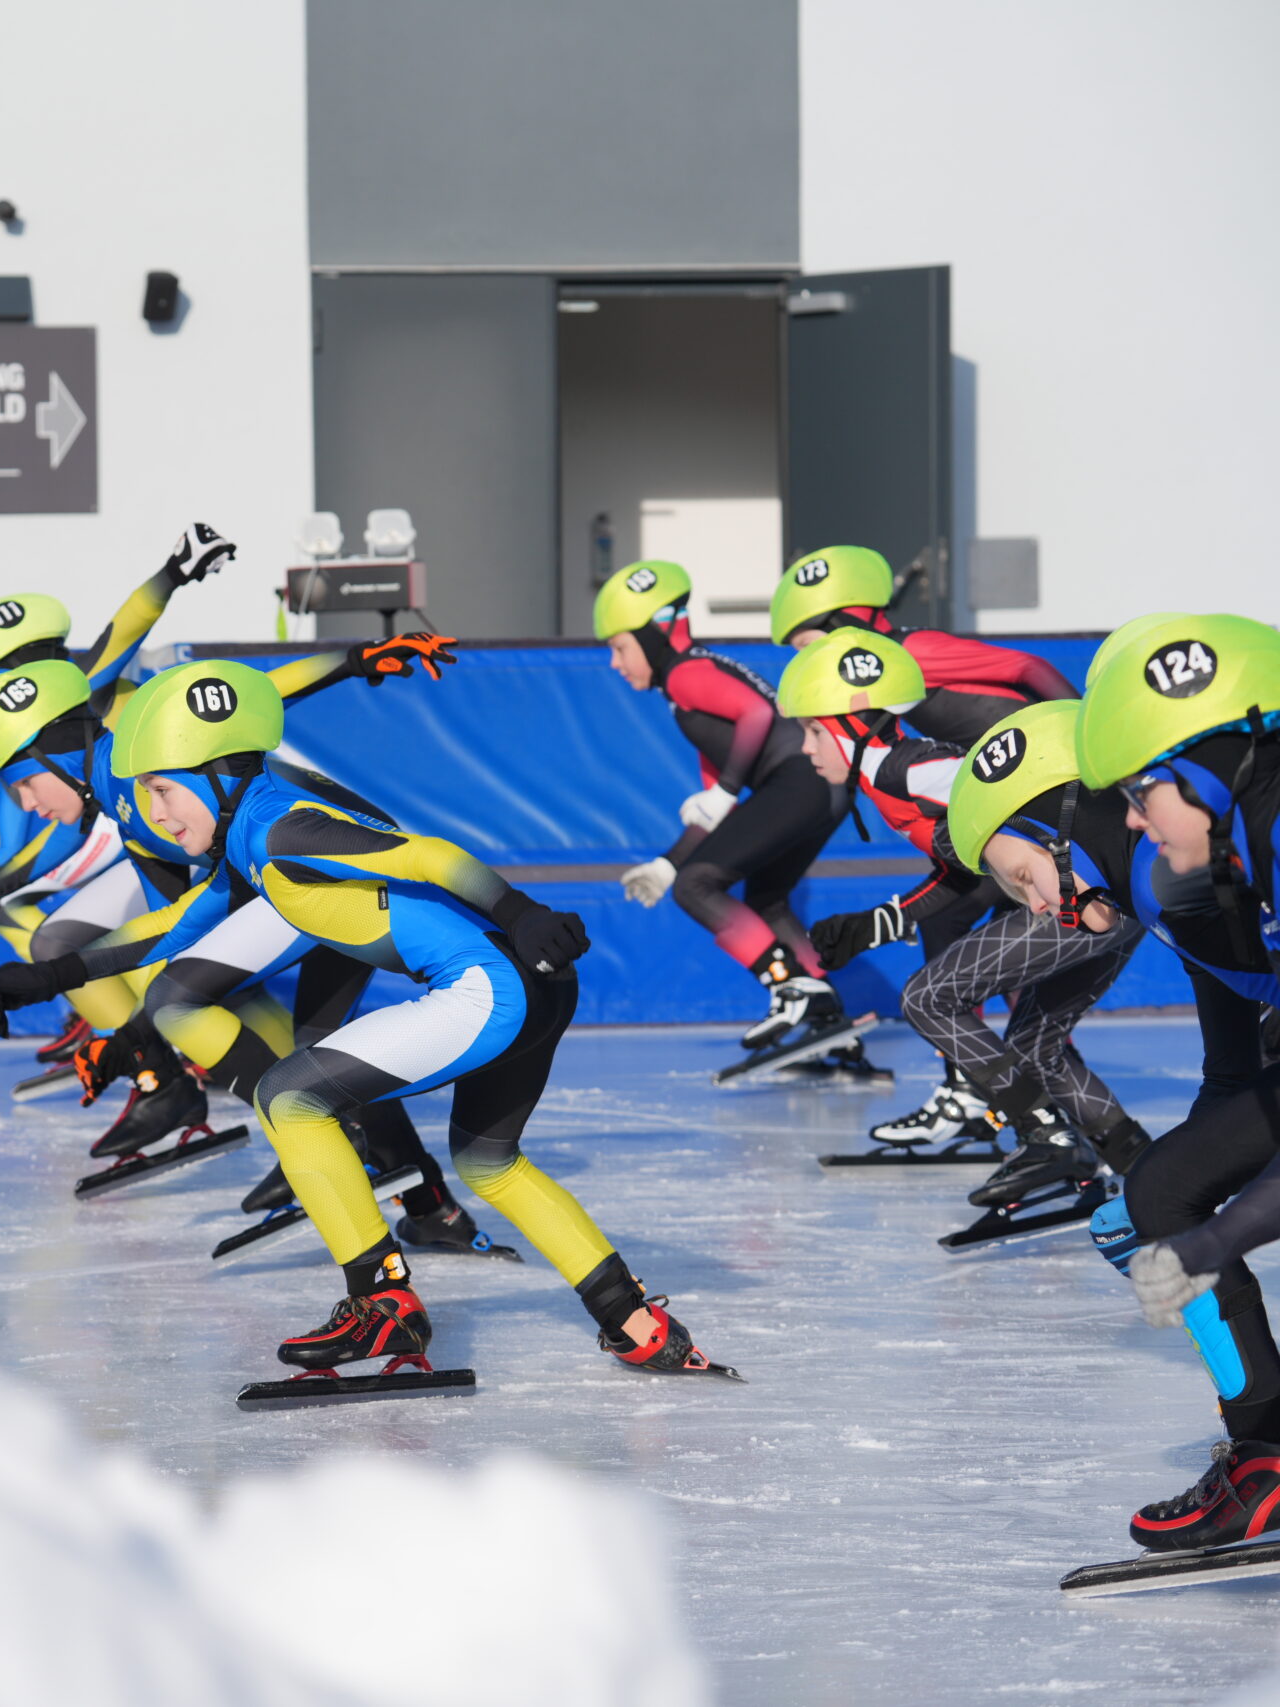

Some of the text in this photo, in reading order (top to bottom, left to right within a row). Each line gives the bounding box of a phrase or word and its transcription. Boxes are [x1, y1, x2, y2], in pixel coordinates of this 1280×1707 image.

[797, 559, 827, 584] 173
[844, 654, 881, 680] 152
[1148, 642, 1213, 692] 124
[192, 685, 231, 712] 161
[975, 729, 1017, 777] 137
